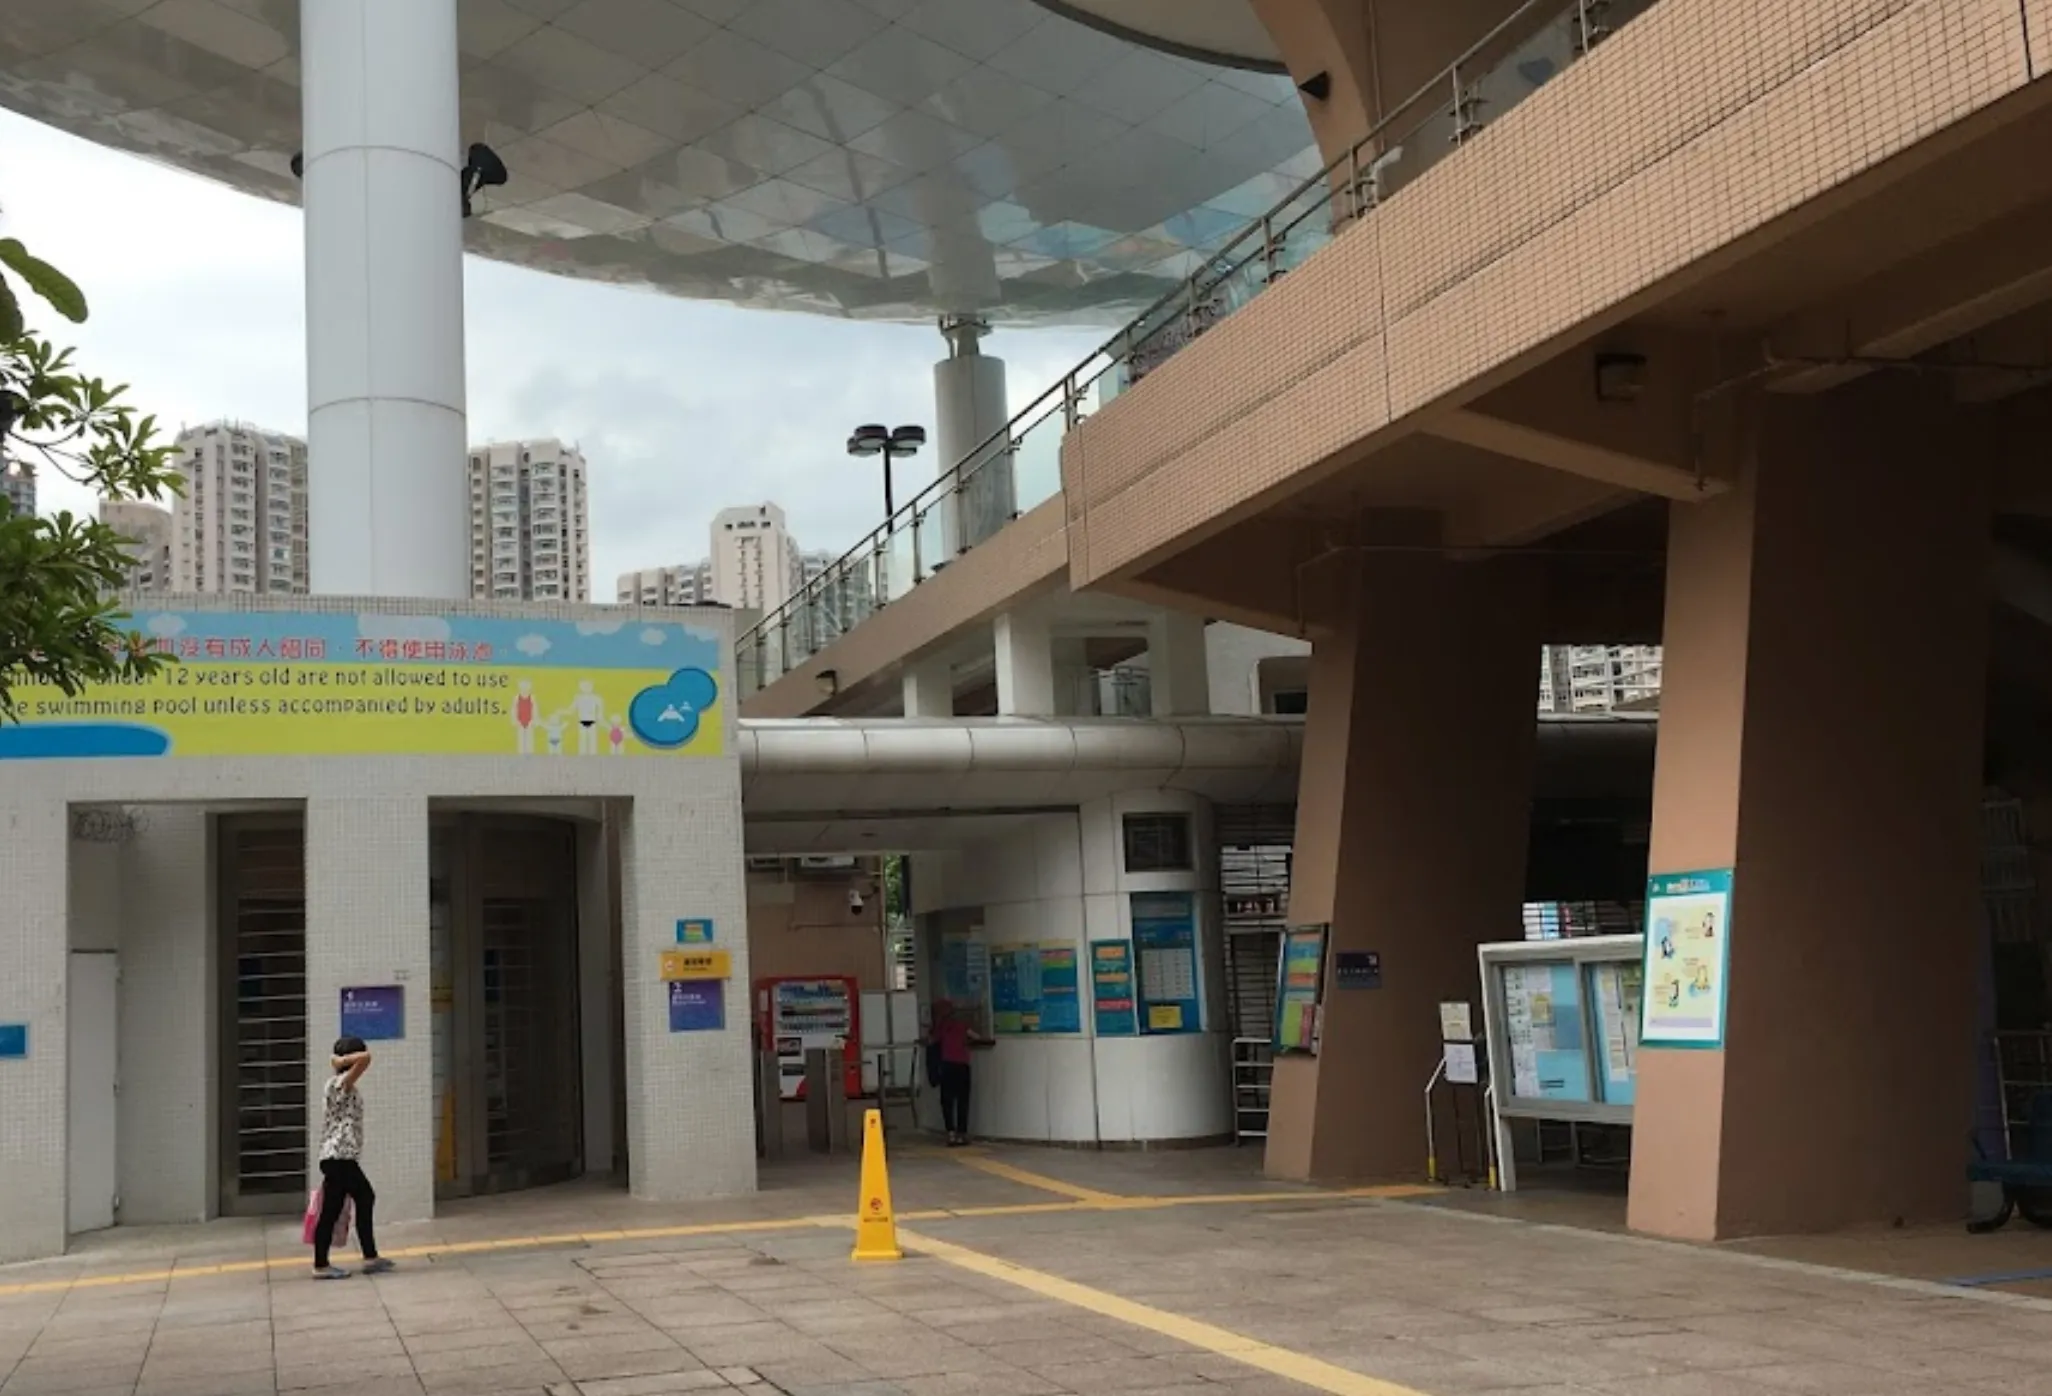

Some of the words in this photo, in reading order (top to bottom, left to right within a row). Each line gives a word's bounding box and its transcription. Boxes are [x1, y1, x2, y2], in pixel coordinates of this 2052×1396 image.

[166, 667, 189, 686] 12
[195, 670, 253, 686] years
[259, 667, 290, 686] old
[297, 671, 329, 686] are
[336, 669, 366, 687] not
[372, 668, 445, 687] allowed
[452, 669, 471, 687] to
[477, 673, 509, 688] use
[36, 698, 145, 715] swimming
[153, 696, 197, 715] pool
[203, 696, 271, 715] unless
[278, 696, 408, 714] accompanied
[414, 696, 436, 715] by
[441, 697, 508, 716] adults.
